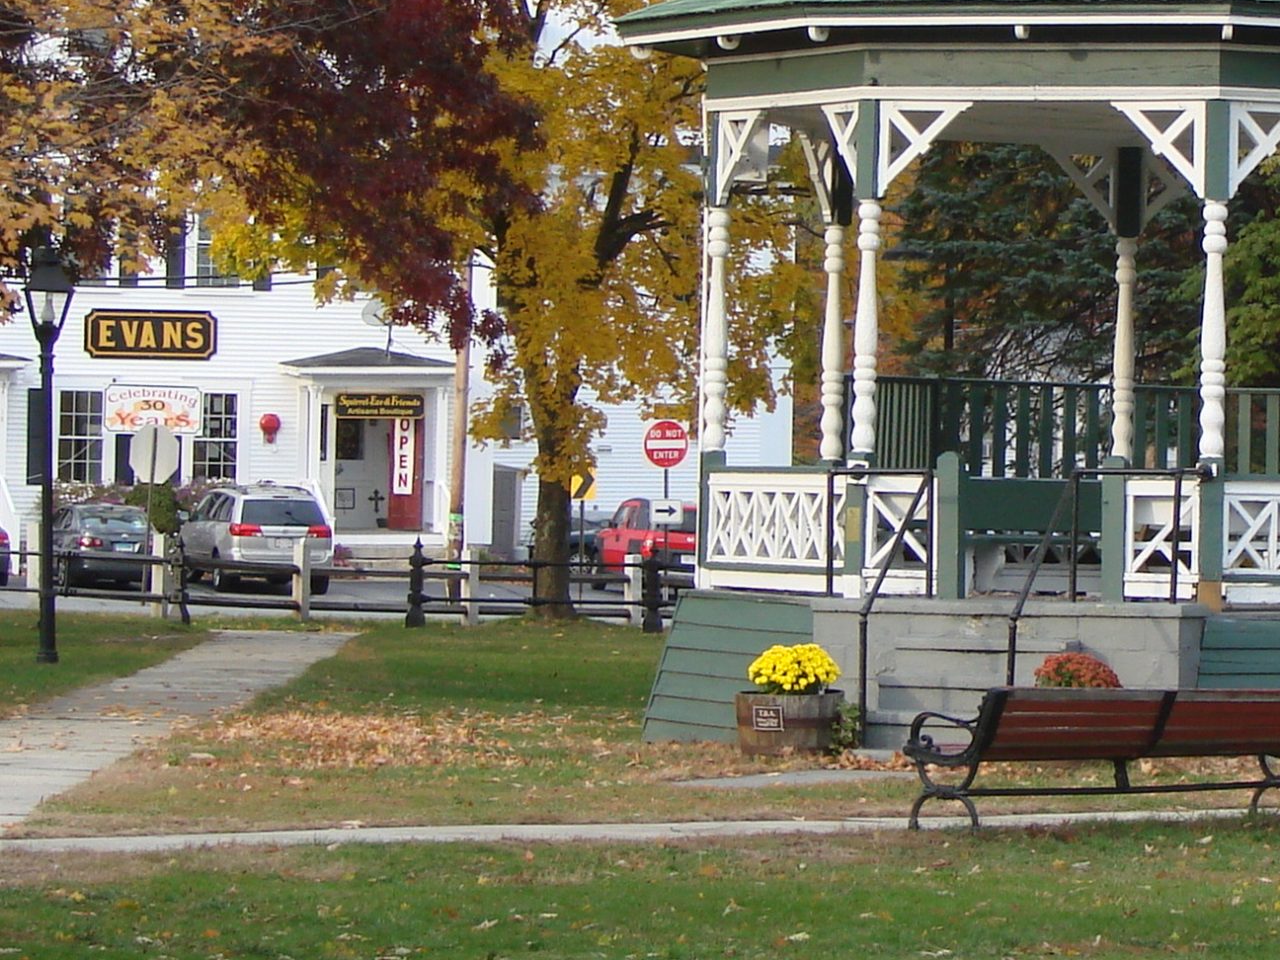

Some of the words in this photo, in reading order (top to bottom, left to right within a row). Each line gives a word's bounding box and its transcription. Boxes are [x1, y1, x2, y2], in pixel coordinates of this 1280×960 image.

[98, 320, 204, 349] EVANS
[108, 389, 198, 409] Celebrating
[140, 400, 165, 411] 30
[650, 430, 661, 438] DO
[665, 430, 681, 438] NOT
[398, 418, 410, 488] OPEN
[653, 451, 679, 459] ENTER
